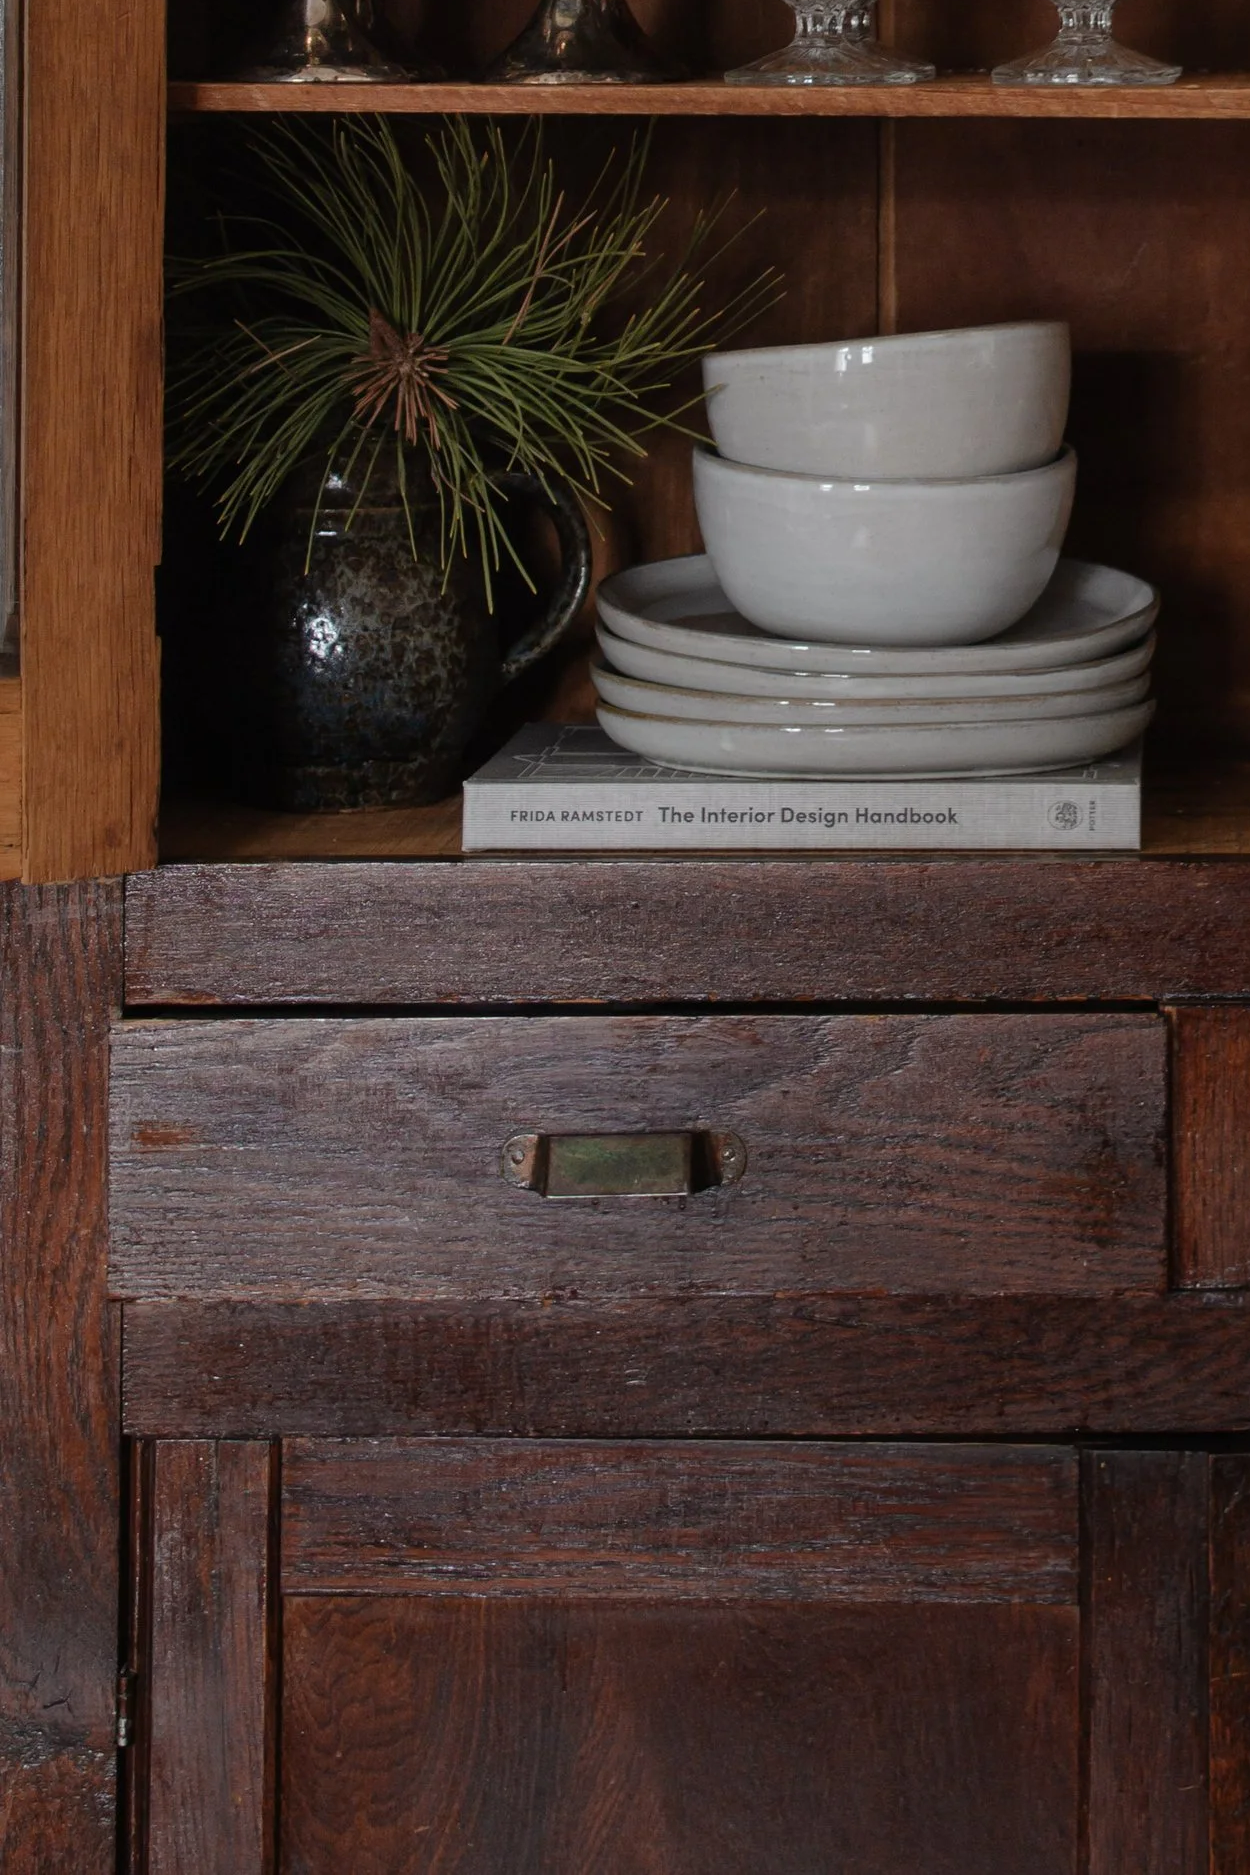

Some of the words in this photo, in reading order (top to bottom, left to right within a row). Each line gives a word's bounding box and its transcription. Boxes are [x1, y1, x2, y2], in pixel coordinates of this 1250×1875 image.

[510, 809, 556, 822] FRIDA
[560, 809, 644, 822] RAMSTEDT
[658, 806, 695, 824] The
[701, 806, 776, 824] Interior
[780, 806, 849, 828] Design
[855, 806, 958, 824] Handbook
[1088, 800, 1096, 832] POTTER
